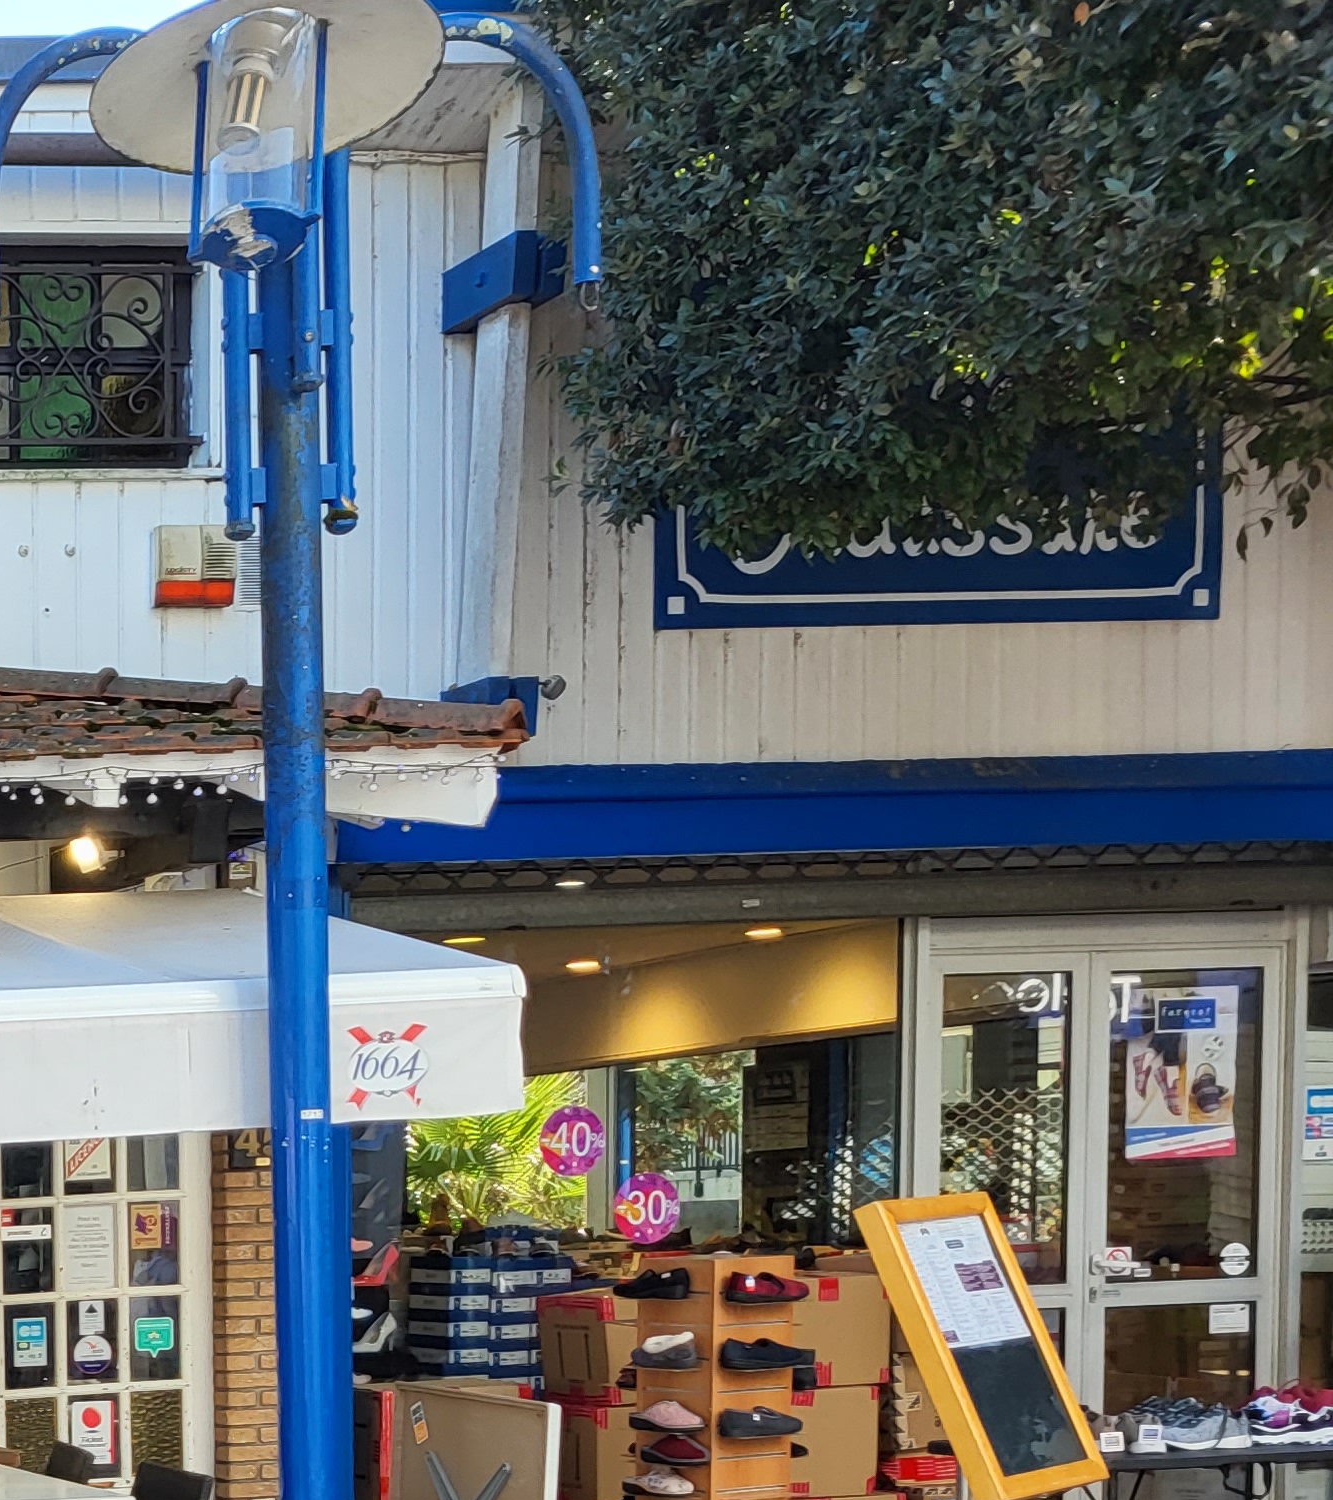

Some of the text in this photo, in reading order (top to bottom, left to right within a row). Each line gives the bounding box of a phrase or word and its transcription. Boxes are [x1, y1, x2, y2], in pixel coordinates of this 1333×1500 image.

[352, 1046, 425, 1081] 1664
[540, 1121, 605, 1157] -40%
[616, 1189, 680, 1225] -30%
